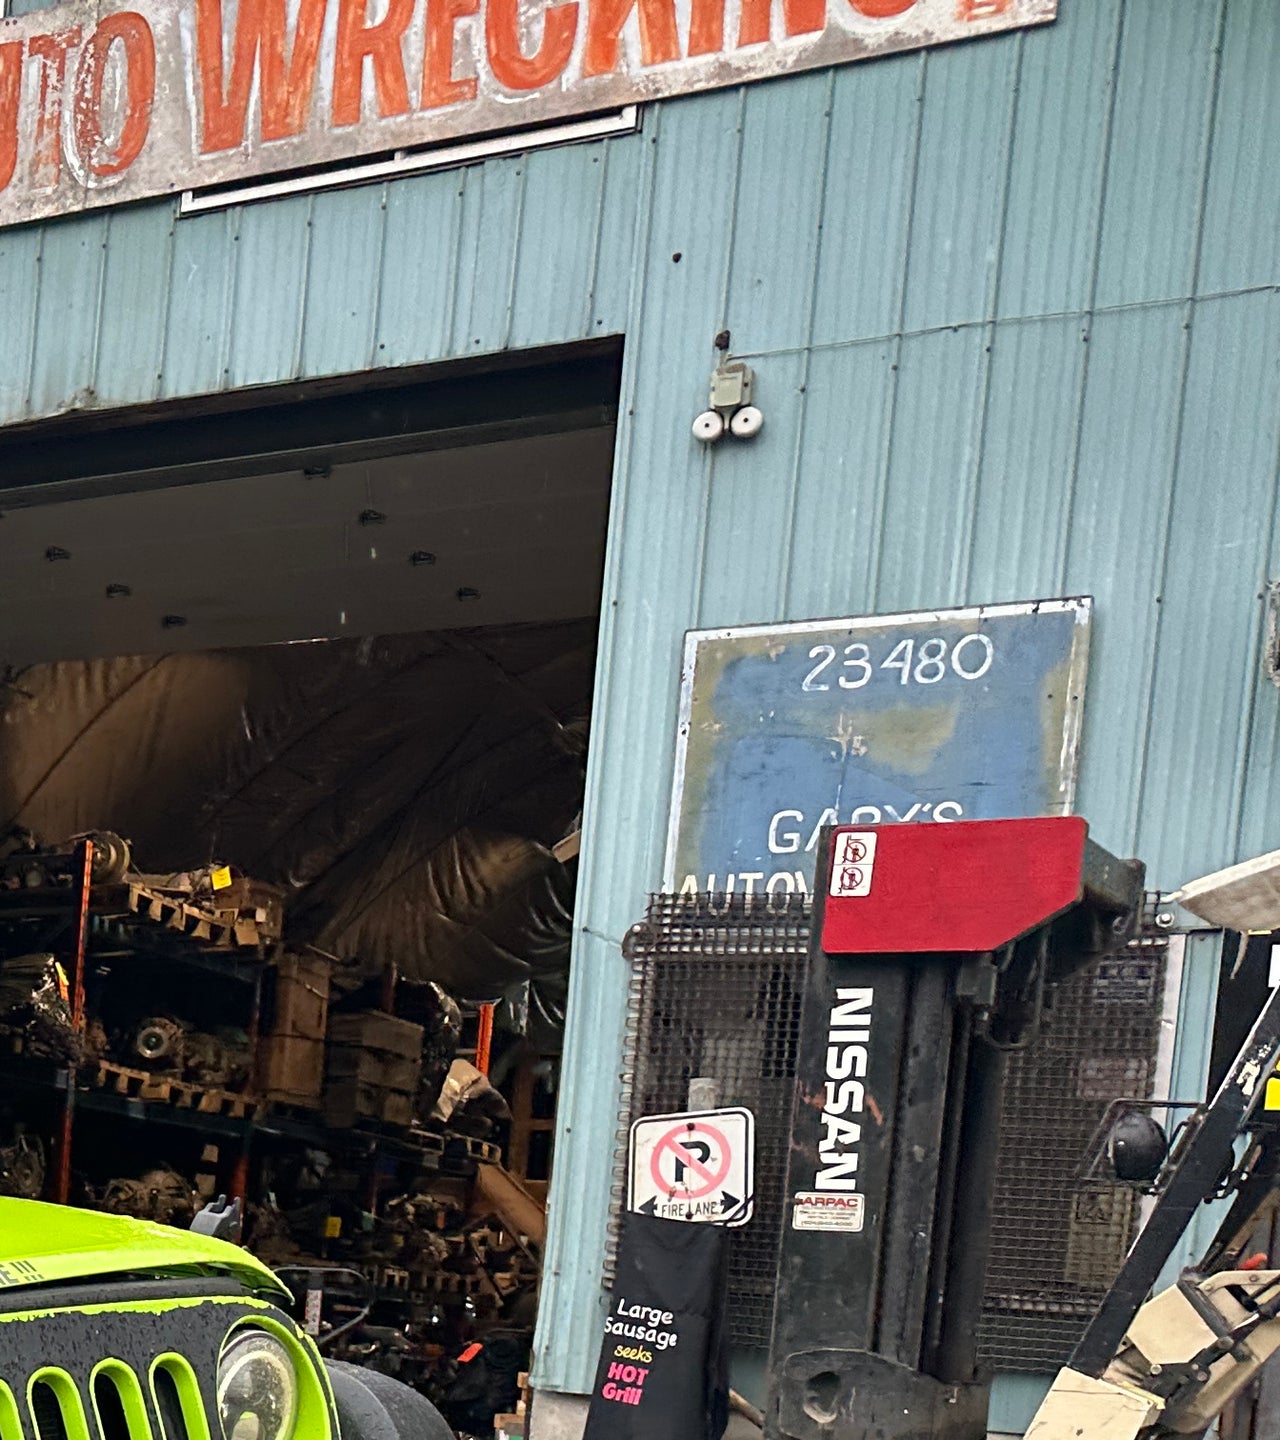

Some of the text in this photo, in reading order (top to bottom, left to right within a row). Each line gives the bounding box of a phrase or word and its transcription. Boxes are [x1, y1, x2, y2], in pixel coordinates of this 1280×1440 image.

[801, 633, 994, 692] 23480
[814, 987, 874, 1190] NISSAN
[661, 1203, 685, 1217] FIRE
[802, 1196, 858, 1208] ARPAC
[616, 1298, 674, 1327] Large
[603, 1316, 678, 1350] Sausage
[613, 1344, 653, 1363] seeks
[607, 1362, 649, 1386] HOT
[602, 1382, 643, 1406] Grill
